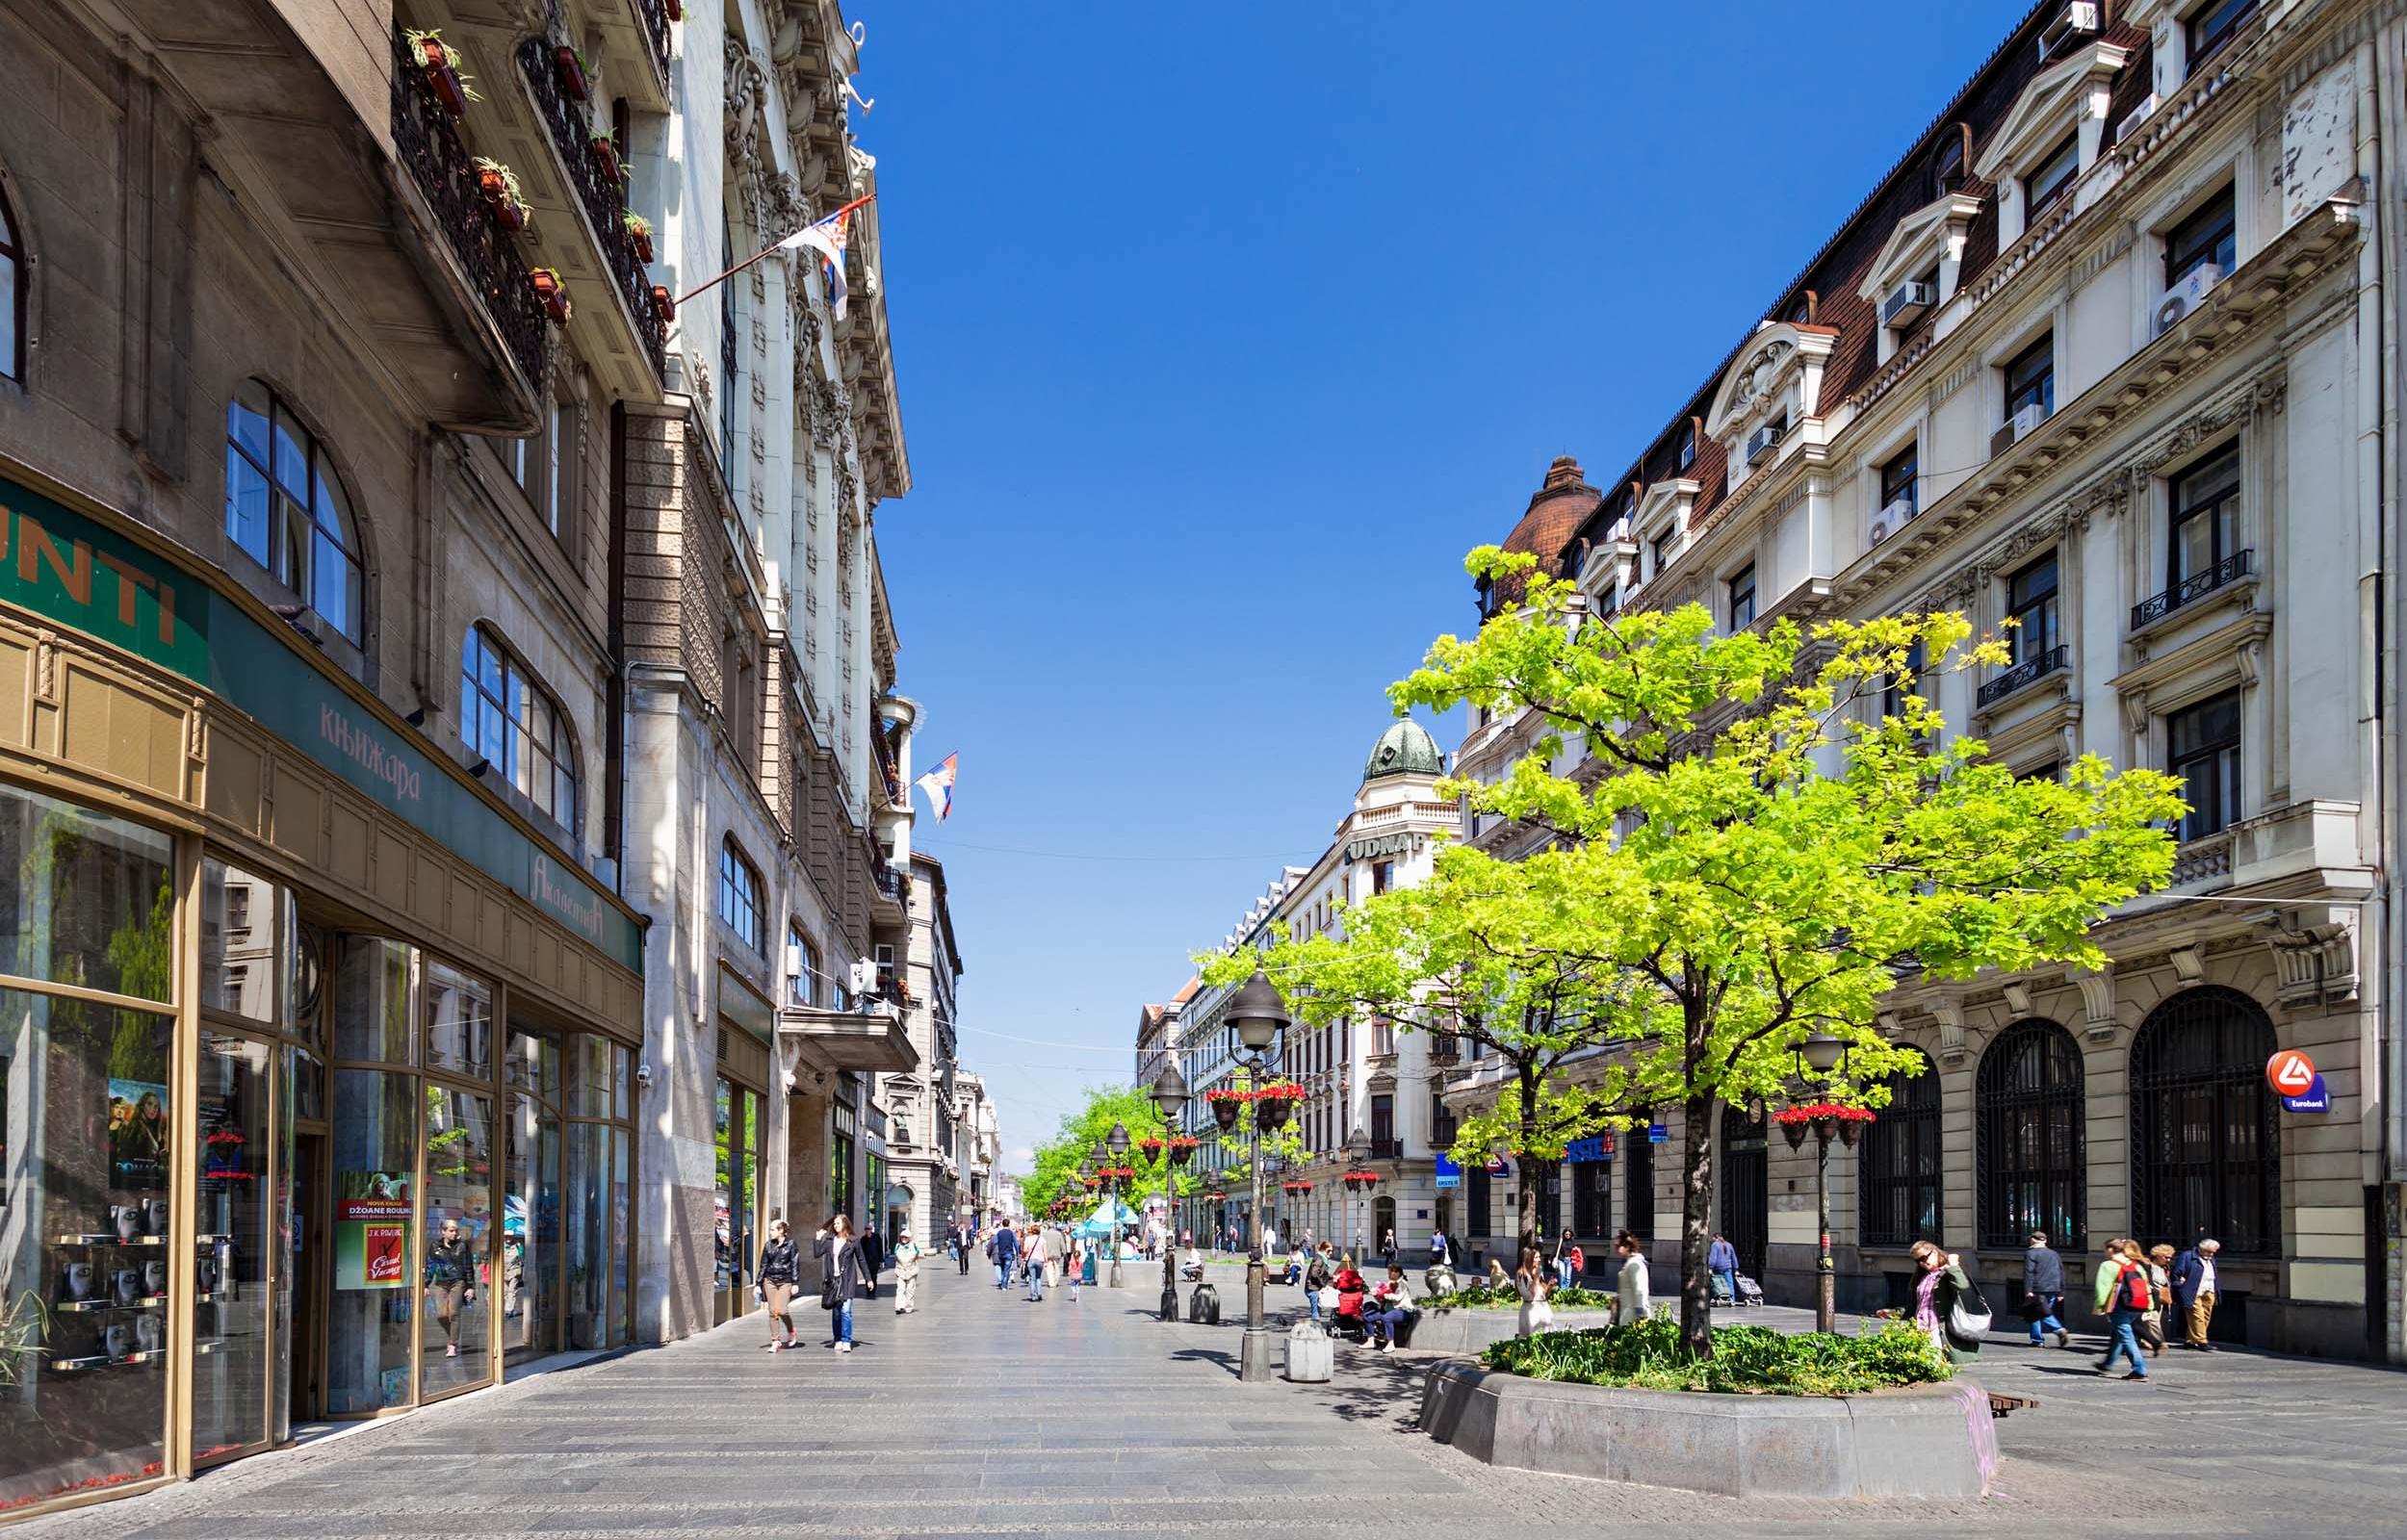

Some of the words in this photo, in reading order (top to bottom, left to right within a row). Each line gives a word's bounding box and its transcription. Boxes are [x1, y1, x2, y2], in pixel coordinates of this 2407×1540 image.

[0, 504, 175, 648] NTI
[2291, 1099, 2323, 1108] Eurobank
[349, 1205, 385, 1215] DŽOANE
